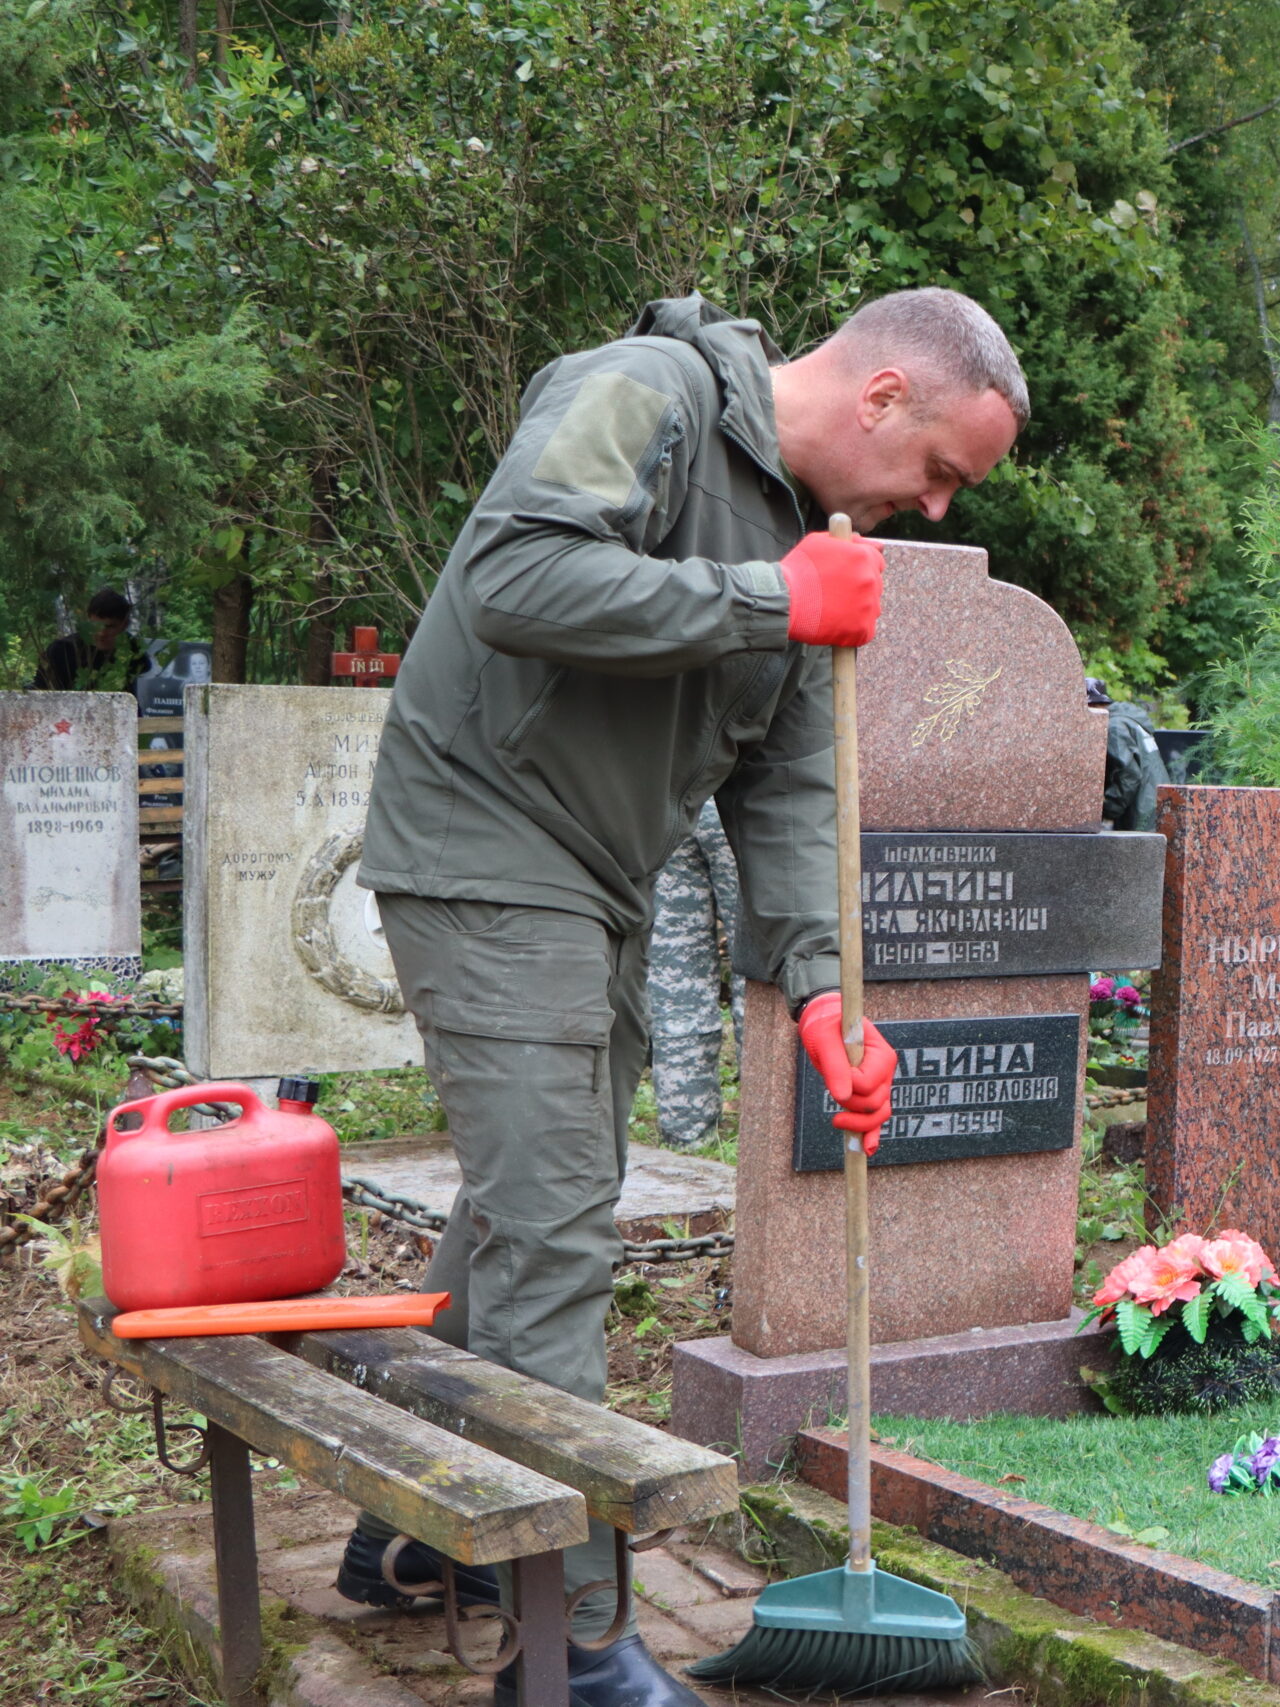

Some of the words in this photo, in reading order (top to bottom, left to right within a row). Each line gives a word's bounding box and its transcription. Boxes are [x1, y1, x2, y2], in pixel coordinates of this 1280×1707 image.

[7, 765, 122, 783] АНТОНЕНКОВ
[223, 853, 293, 864] ДОРОГОМУ
[885, 846, 995, 862] ПОЛКОВНИК
[240, 869, 276, 880] МУЖУ
[869, 871, 1008, 903] ИЛЬИН
[862, 910, 900, 933] ВЕЛ
[916, 908, 1046, 932] ЯКОВЛЕВИЧ
[963, 1077, 1057, 1103] ПАВЛОВНА
